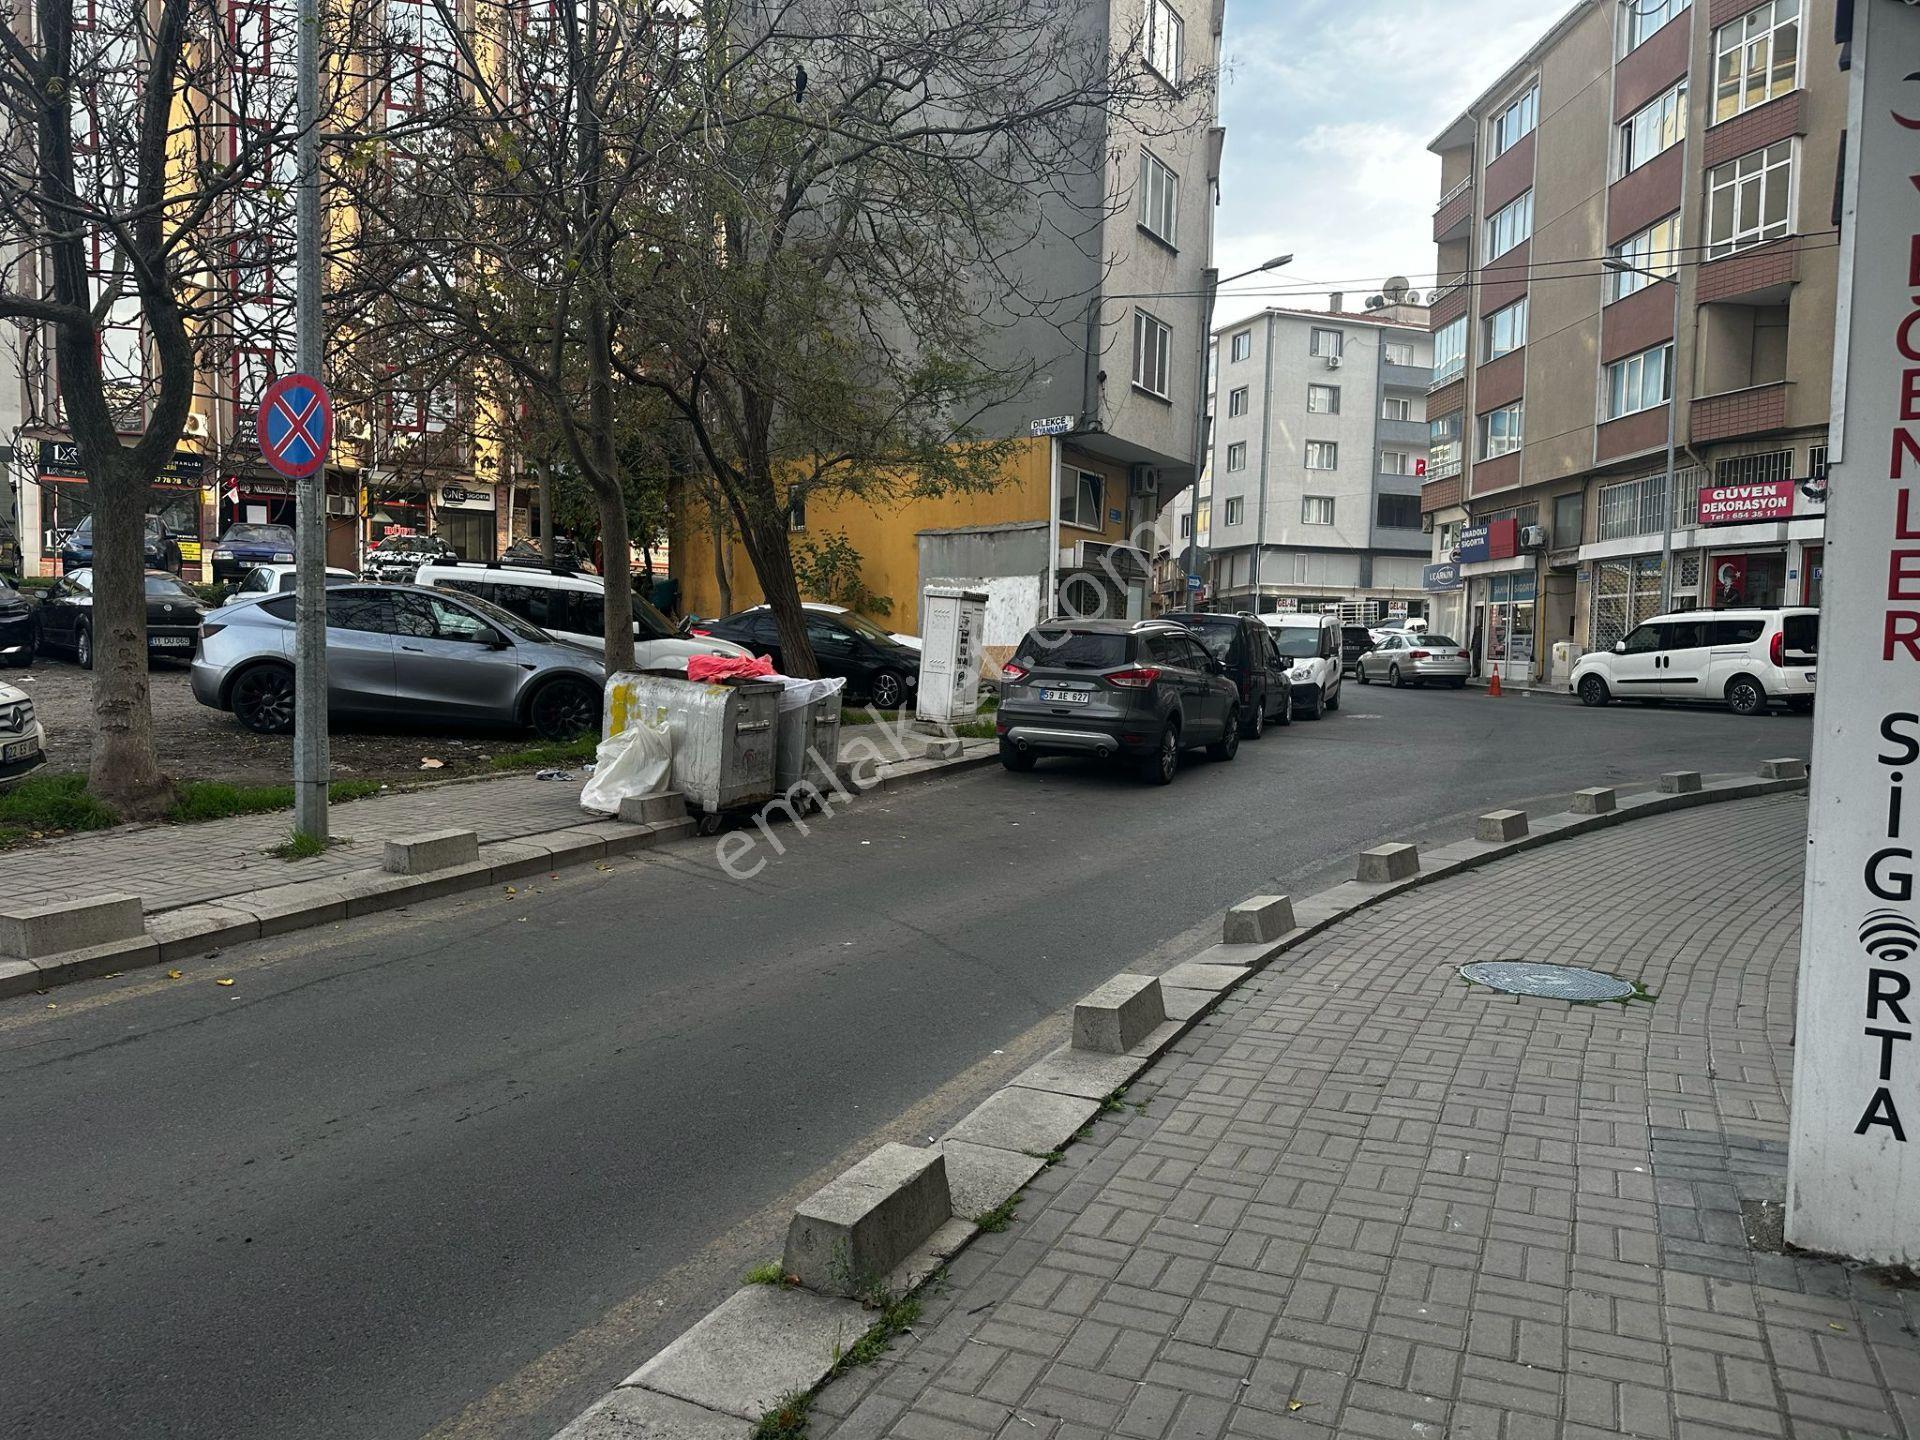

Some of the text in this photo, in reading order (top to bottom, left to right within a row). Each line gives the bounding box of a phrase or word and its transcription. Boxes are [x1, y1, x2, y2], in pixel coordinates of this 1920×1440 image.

[1713, 485, 1777, 500] GÜVEN
[1702, 497, 1787, 513] DEKORASYON
[1461, 527, 1488, 538] ANADOLU
[1045, 691, 1088, 702] 59 AE 627
